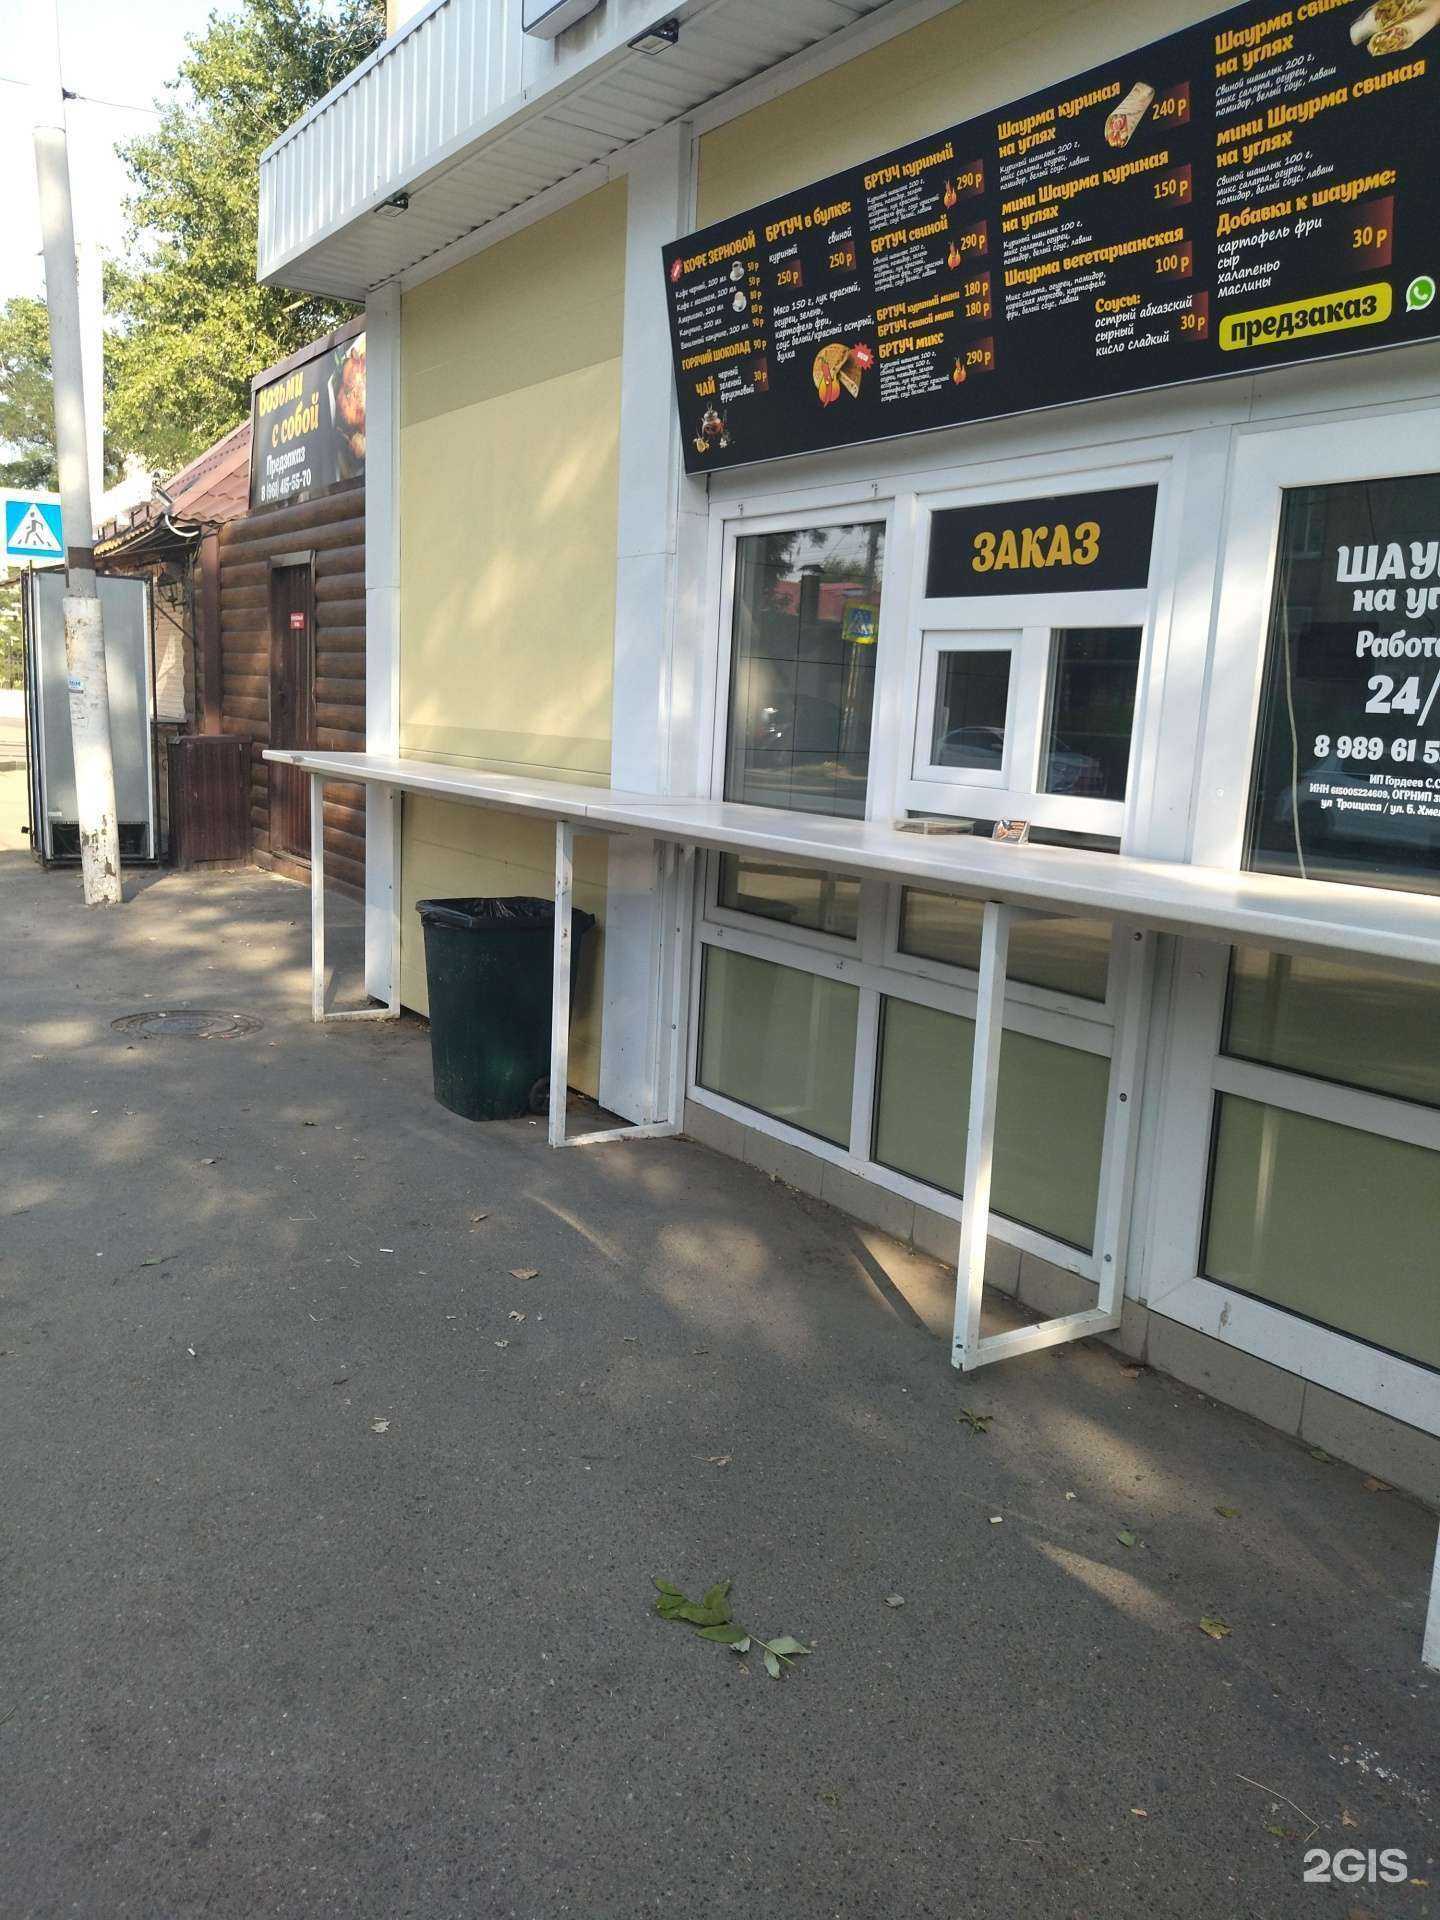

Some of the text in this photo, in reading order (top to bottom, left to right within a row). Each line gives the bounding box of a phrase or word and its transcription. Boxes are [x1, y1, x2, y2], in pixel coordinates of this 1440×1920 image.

[1215, 11, 1293, 55] Шаурма
[1215, 34, 1293, 78] на углях
[1216, 55, 1304, 96] Свиной шашлык 200
[1216, 66, 1337, 117] помидор, белый соус, лаваш
[1217, 59, 1426, 147] мини Шаурма свиная
[997, 81, 1121, 141] Шаурма куриная
[1152, 98, 1175, 120] 240
[999, 127, 1056, 158] на углях
[1216, 130, 1293, 168] на углях
[864, 142, 954, 190] БРТУЧ куриный
[1216, 152, 1303, 187] Свиной шашлык 100
[957, 172, 974, 190] 290
[1001, 151, 1169, 216] мини Шаурма куриная
[1153, 179, 1176, 199] 150
[1216, 163, 1306, 197] микс салата, огурец,
[1216, 164, 1334, 206] помидор, белый соус, лаваш
[1216, 169, 1396, 238] Добавки к шаурме:
[765, 218, 803, 243] БРТУЧ
[813, 200, 852, 229] булке:
[1002, 205, 1059, 232] на углях
[827, 226, 852, 245] свиной
[870, 213, 948, 254] БРТУЧ свиной
[960, 233, 977, 251] 290
[1217, 217, 1322, 254] картофель фри
[1353, 226, 1373, 248] 30
[683, 229, 757, 273] КОФЕ ЗЕРНОВОЙ
[768, 244, 798, 264] куриный
[829, 252, 845, 268] 250
[1004, 226, 1184, 287] Шаурма вегетарианская
[1155, 255, 1177, 273] 100
[1217, 255, 1240, 271] сыр
[777, 270, 792, 286] 250
[1217, 260, 1280, 285] халапеньо
[773, 305, 789, 317] Мясо
[791, 299, 806, 311] 150
[829, 281, 861, 301] красный,
[964, 281, 980, 297] 180
[1217, 276, 1272, 299] маслины
[965, 302, 981, 317] 180
[1095, 293, 1141, 314] Соусы:
[1095, 295, 1193, 328] острый абхазский
[1095, 323, 1134, 343] сырный
[1180, 314, 1195, 330] 30
[1231, 295, 1378, 346] предзаказ
[713, 340, 751, 361] ШОКОЛАД
[878, 336, 913, 359] БРТУЧ
[915, 332, 944, 349] микс
[1096, 330, 1170, 357] кисло сладкий
[966, 350, 983, 365] 290
[696, 375, 716, 397] ЧАЙ
[271, 392, 319, 448] с собой
[266, 446, 306, 479] Предзаказ
[972, 521, 1101, 572] ЗАКАЗ
[1336, 541, 1440, 582] ШАУ
[1353, 588, 1396, 612] на
[1314, 734, 1440, 764] 8 989 61 5
[1309, 783, 1330, 794] ИНН
[1392, 789, 1432, 802] ОГРНИП
[1369, 774, 1384, 785] ИП
[1385, 775, 1423, 788] Гордеев
[1320, 799, 1333, 809] ул
[1336, 798, 1382, 812] Троицкая
[1406, 803, 1416, 815] Б.
